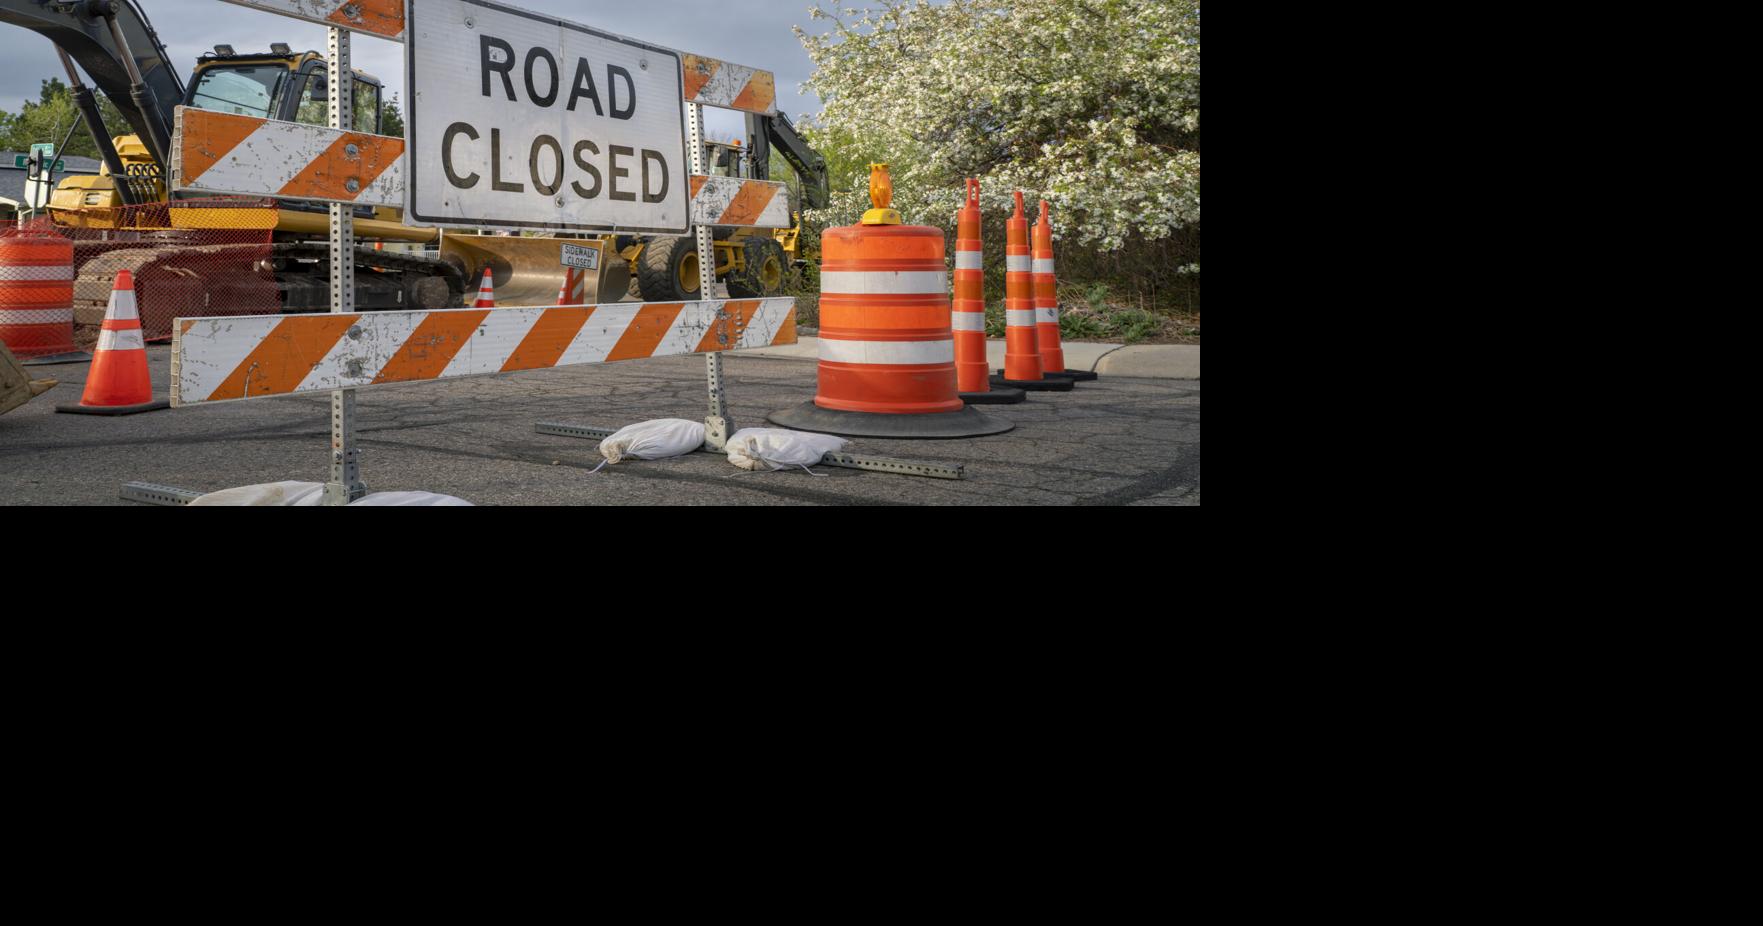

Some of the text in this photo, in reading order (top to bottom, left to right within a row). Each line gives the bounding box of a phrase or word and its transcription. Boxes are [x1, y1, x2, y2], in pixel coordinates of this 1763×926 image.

[479, 34, 637, 121] ROAD
[441, 121, 670, 204] CLOSED
[565, 246, 595, 258] SIDEWALK
[567, 256, 592, 267] CLOSED
